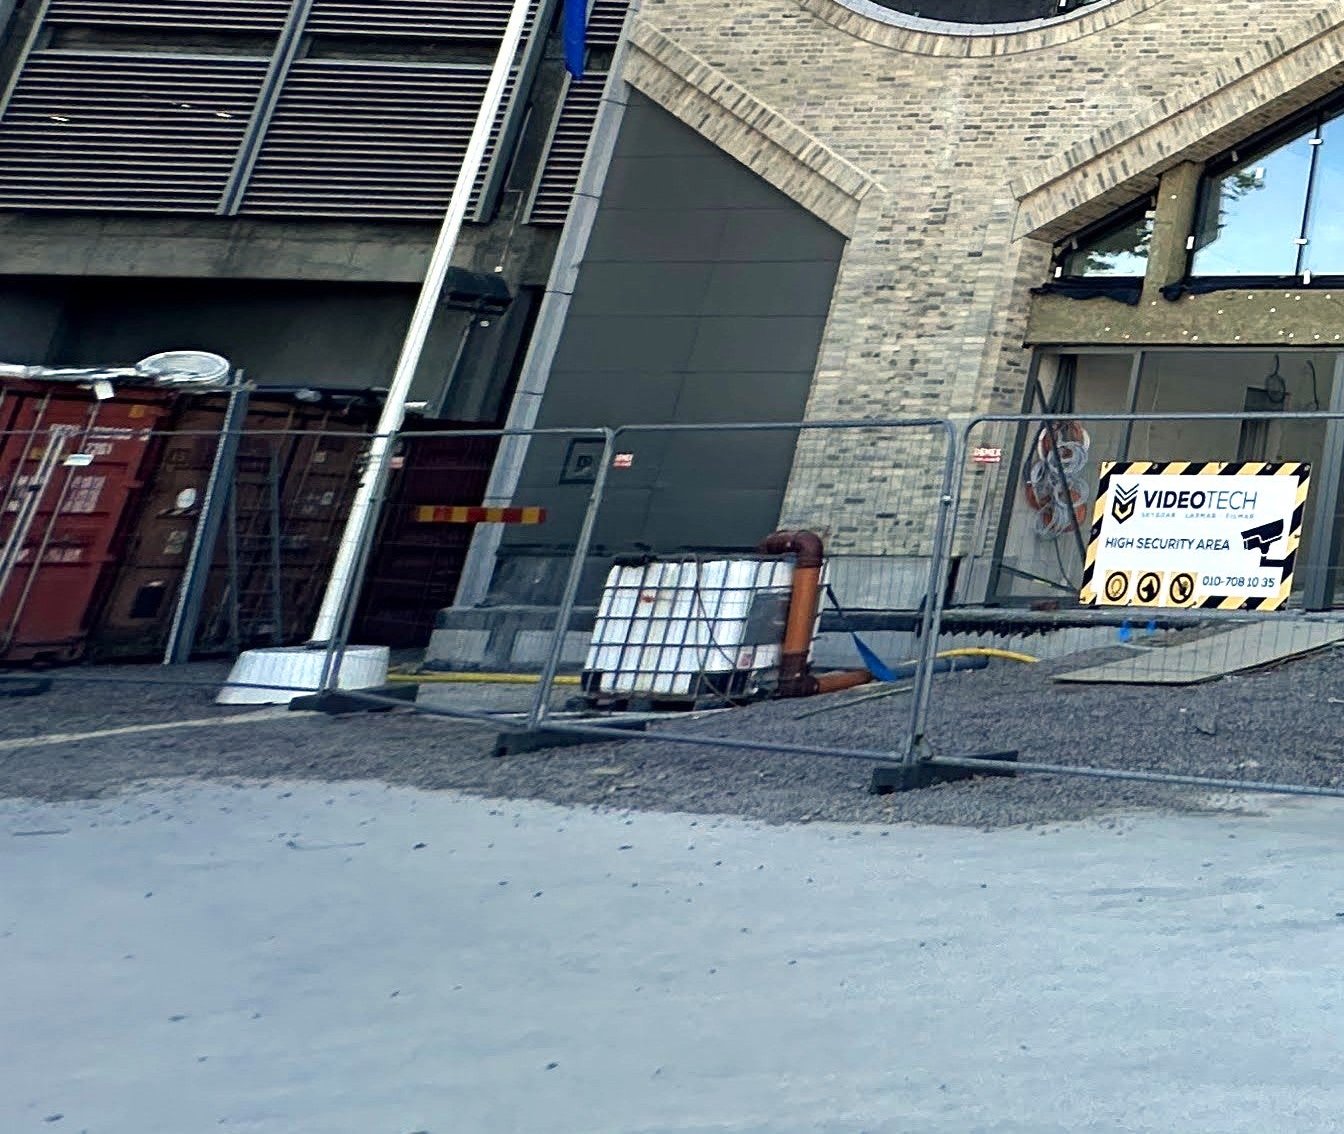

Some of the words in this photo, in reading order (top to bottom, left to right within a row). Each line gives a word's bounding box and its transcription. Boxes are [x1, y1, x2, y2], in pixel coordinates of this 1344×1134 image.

[1143, 490, 1258, 510] VIDEOTECH
[1105, 537, 1134, 549] HIGH
[1136, 538, 1194, 550] SECURITY
[1195, 539, 1230, 551] AREA
[1202, 576, 1245, 587] 010-708
[1247, 577, 1259, 588] 10
[1261, 577, 1275, 588] 35
